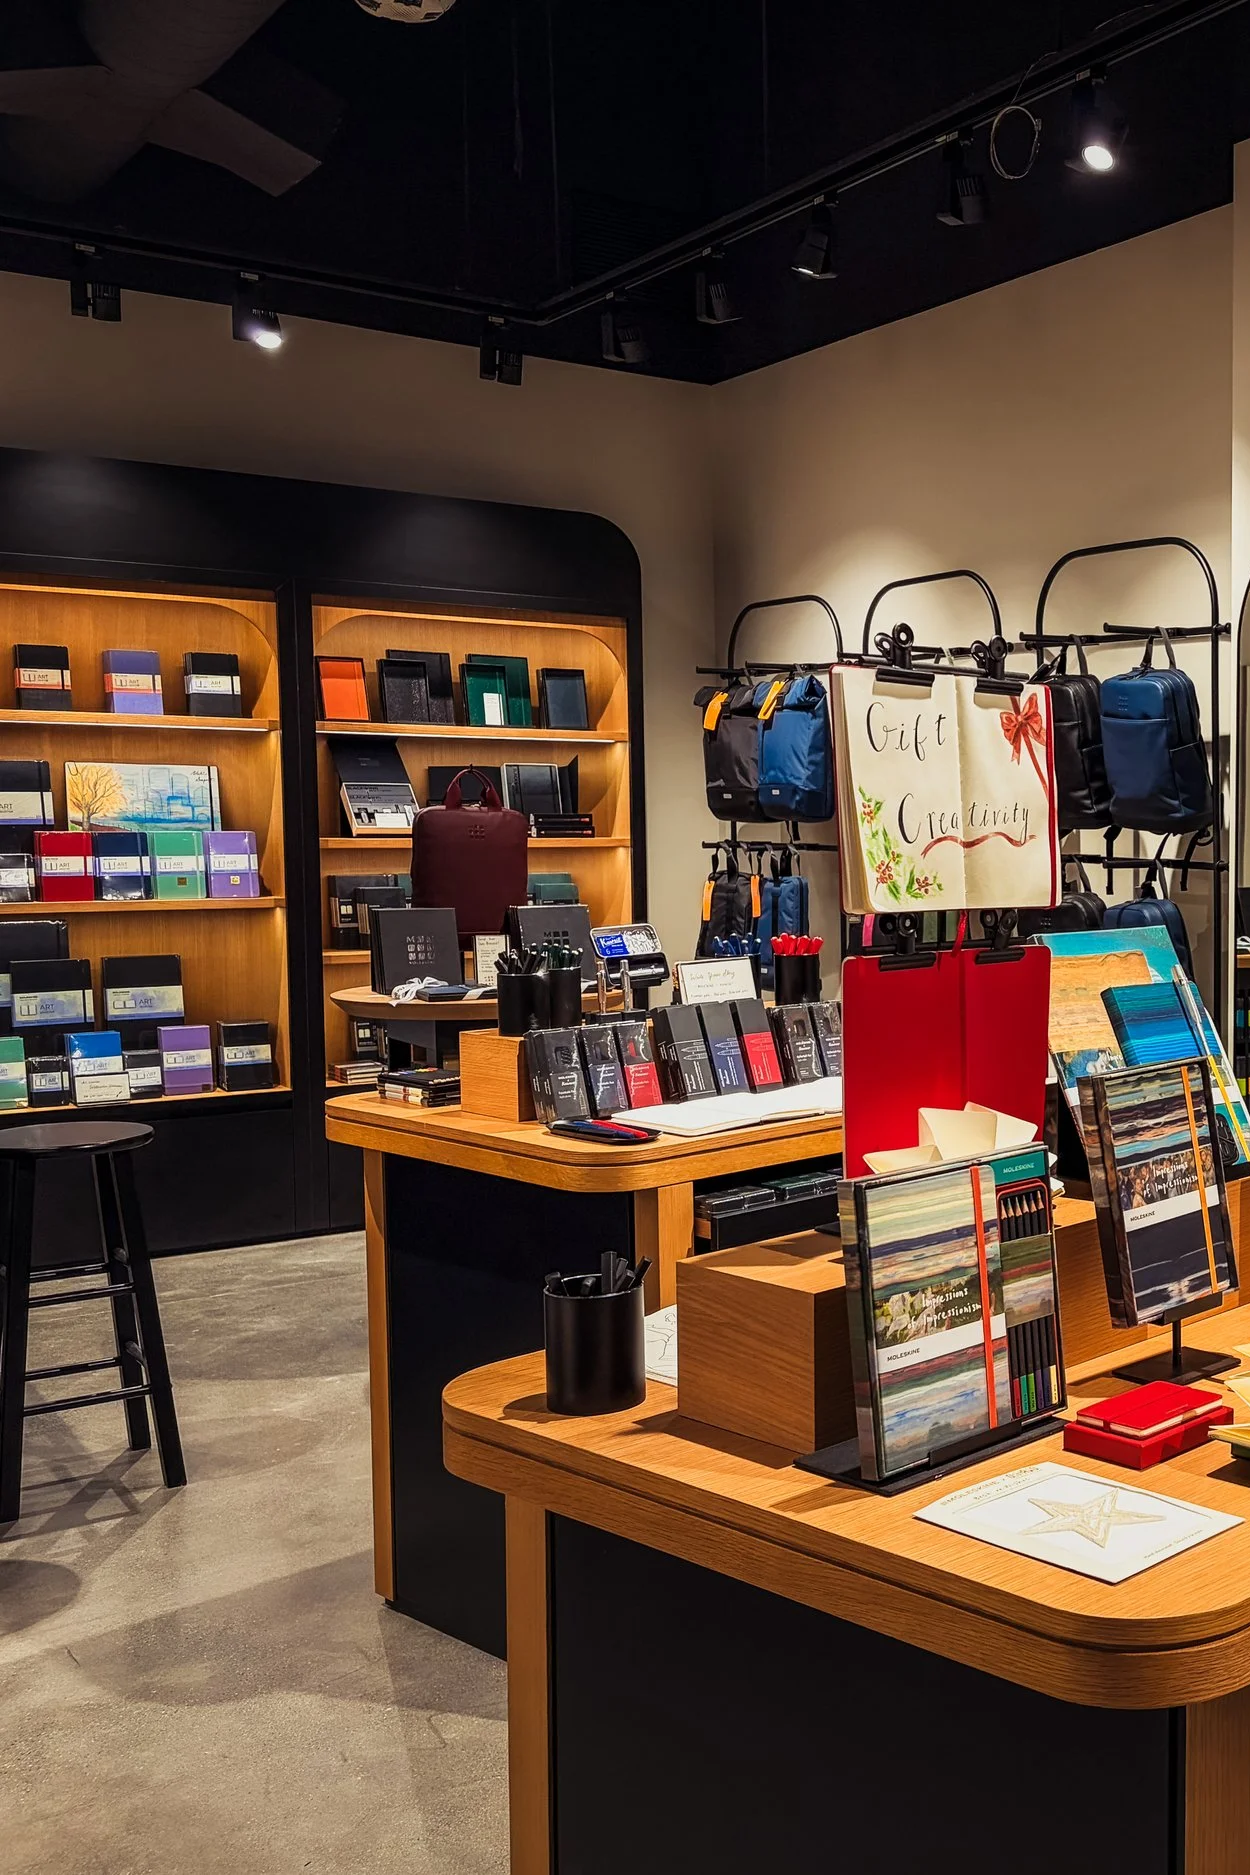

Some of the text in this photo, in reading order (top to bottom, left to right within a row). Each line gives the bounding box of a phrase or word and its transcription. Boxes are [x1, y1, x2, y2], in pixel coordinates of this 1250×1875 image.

[866, 701, 946, 761] Gift
[897, 792, 1030, 845] Creativity
[1002, 1162, 1035, 1174] MOLESKINE
[1130, 1210, 1156, 1222] MOLESKINE
[922, 1287, 969, 1310] Impressions
[907, 1315, 916, 1330] of
[887, 1347, 921, 1362] MOLESKINE
